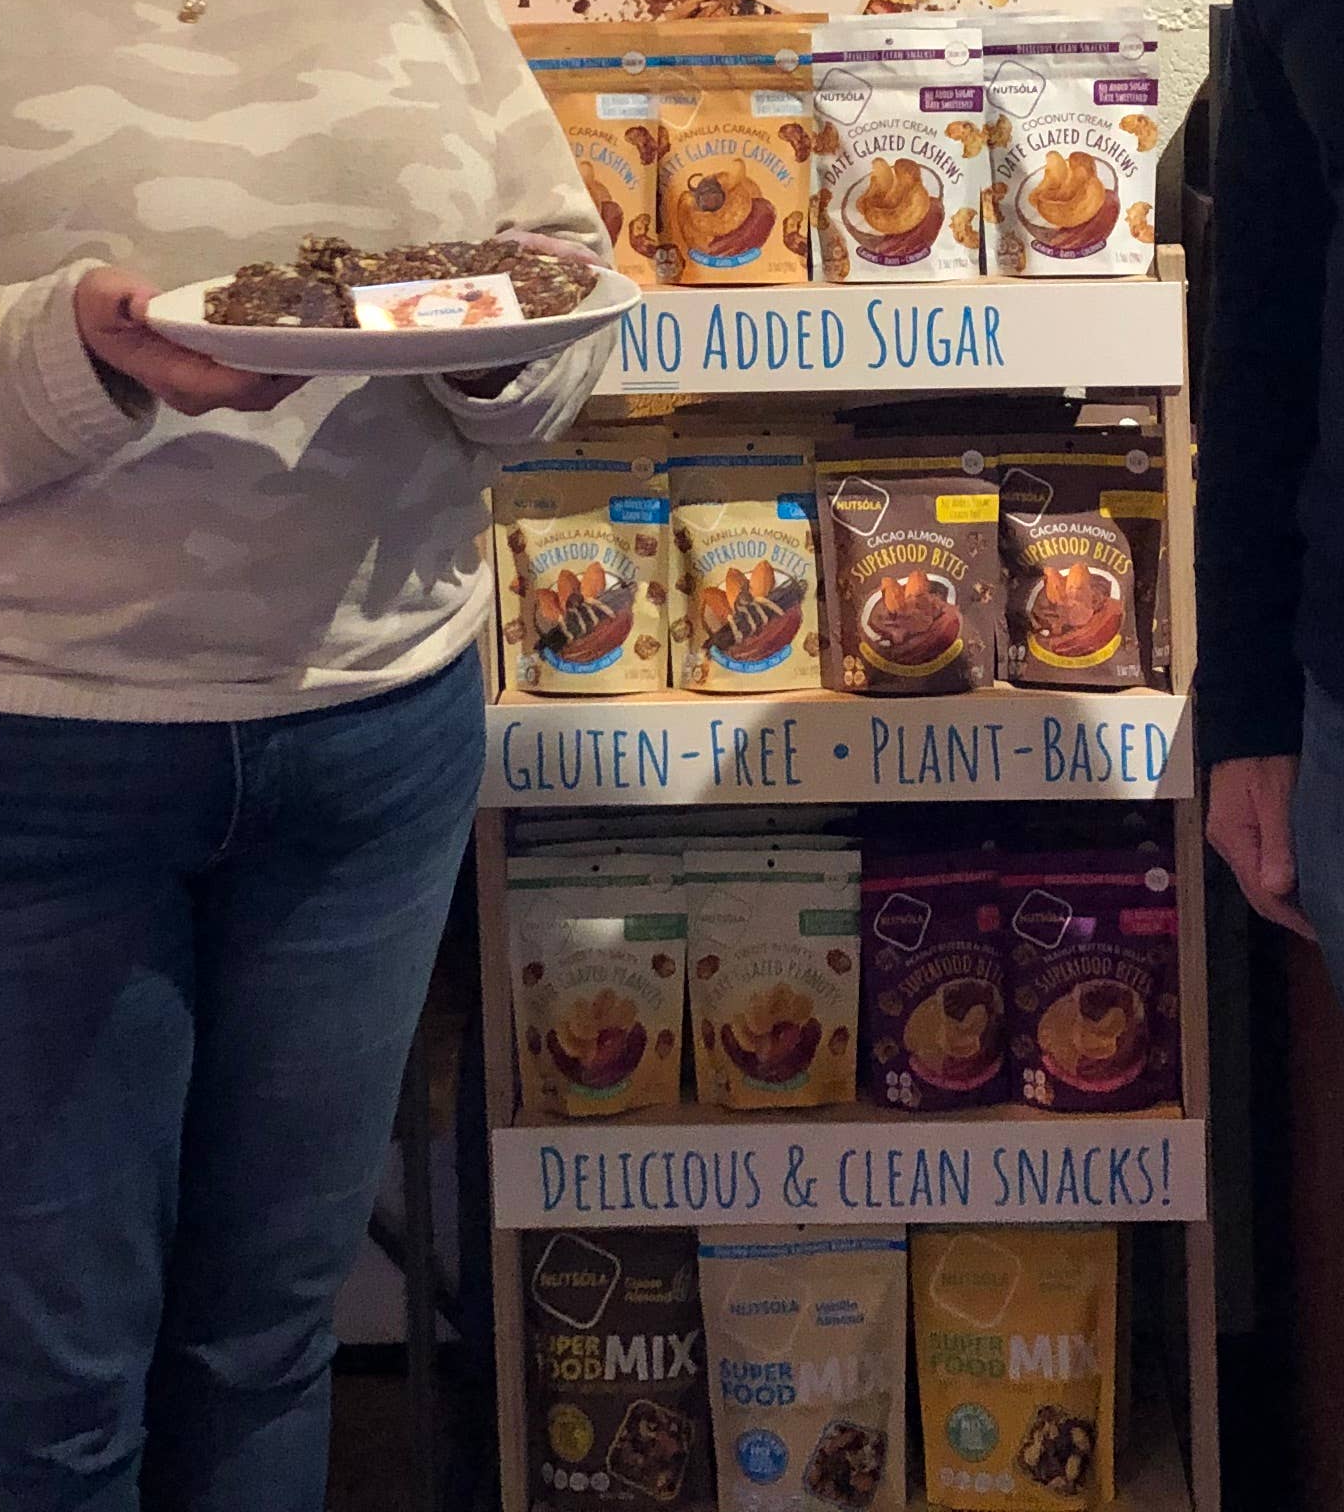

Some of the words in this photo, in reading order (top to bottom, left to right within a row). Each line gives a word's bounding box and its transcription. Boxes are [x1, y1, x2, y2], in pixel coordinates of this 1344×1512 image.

[847, 118, 901, 139] COCONUT
[903, 119, 938, 138] CREAM
[1022, 112, 1076, 132] COCONUT
[1077, 113, 1113, 131] CREAM
[685, 139, 738, 163] GLAZED
[742, 139, 796, 187] CASHEWS
[824, 150, 854, 186] DATE
[853, 134, 905, 159] GLAZED
[911, 135, 964, 185] CASHEWS
[997, 143, 1027, 179] DATE
[1027, 128, 1080, 152] GLAZED
[1085, 128, 1139, 179] CASHEWS
[621, 302, 682, 372] NO
[703, 303, 845, 370] ADDED
[867, 299, 1005, 369] SUGAR
[534, 530, 582, 549] VANILLA
[583, 529, 632, 552] ALMOND
[702, 528, 748, 546] VANILLA
[750, 527, 801, 549] ALMOND
[867, 530, 905, 548] CACAO
[907, 530, 955, 548] ALMOND
[1029, 523, 1068, 539] CACAO
[1069, 523, 1117, 543] ALMOND
[528, 543, 599, 580] SUPERFOOD
[603, 545, 641, 580] BITES
[694, 540, 767, 577] SUPERFOOD
[771, 542, 811, 580] BITES
[851, 543, 928, 584] SUPERFOOD
[931, 546, 969, 581] BITES
[1093, 542, 1133, 575] BITES
[503, 719, 802, 791] GLUTEN-FREE
[871, 716, 1168, 784] PLANT-BASED
[540, 1146, 761, 1210] DELICIOUS
[782, 1144, 818, 1208] &
[838, 1148, 970, 1207] CLEAN
[993, 1138, 1170, 1206] SNACKS!
[604, 1330, 699, 1381] MIX
[721, 1379, 797, 1407] FOOD
